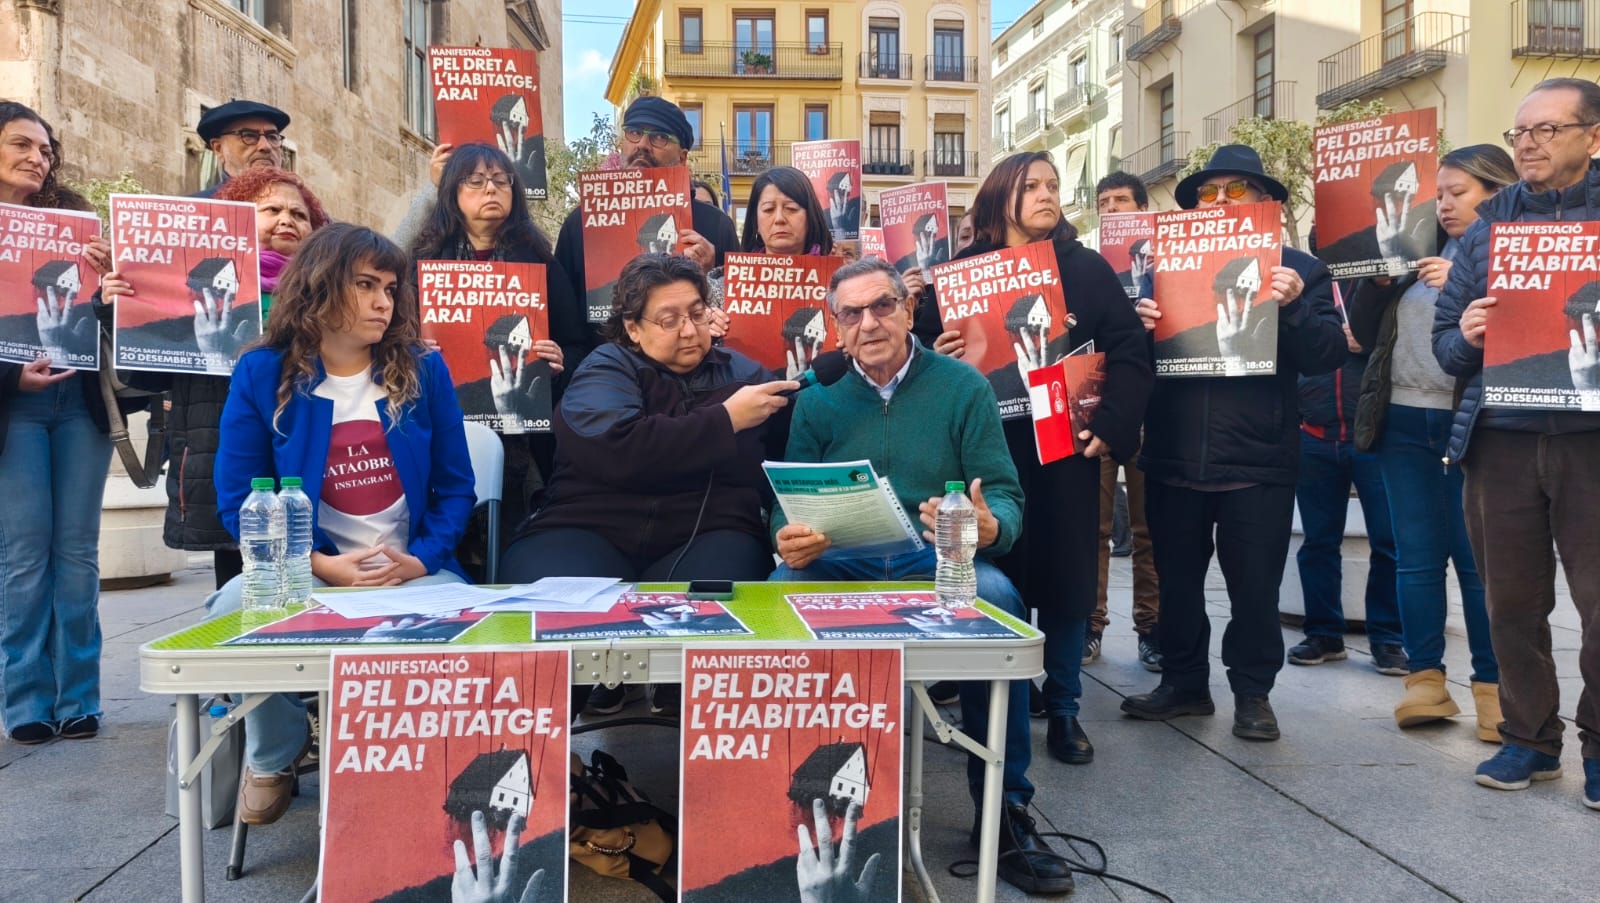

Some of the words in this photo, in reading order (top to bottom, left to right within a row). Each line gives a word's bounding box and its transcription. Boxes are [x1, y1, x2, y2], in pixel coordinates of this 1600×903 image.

[431, 48, 492, 56] MANIFESTACIÓ
[432, 58, 460, 70] PEL
[463, 58, 502, 72] DRET
[505, 60, 516, 72] A
[434, 72, 537, 92] L'HABITATGE,
[436, 88, 478, 100] ARA!
[1316, 118, 1382, 136] MANIFESTACIÓ
[1316, 135, 1344, 152] PEL
[1349, 126, 1394, 146] DRET
[1396, 124, 1410, 138] A
[1316, 137, 1434, 167] L'HABITATGE,
[582, 170, 642, 181] MANIFESTACIÓ
[804, 170, 820, 178] RA!
[1316, 164, 1360, 183] ARA!
[583, 182, 610, 196] PEL
[613, 180, 653, 195] DRET
[655, 178, 668, 192] A
[116, 200, 196, 213] MANIFESTACIÓ
[584, 193, 689, 212] L'HABITATGE,
[882, 198, 897, 208] PEL
[898, 193, 922, 204] DRET
[924, 192, 932, 200] A
[0, 208, 45, 221] FESTACIÓ
[118, 211, 152, 228] PEL
[158, 214, 210, 230] DRET
[212, 218, 227, 232] A
[585, 212, 626, 228] ARA!
[884, 215, 906, 226] ARA!
[1157, 208, 1225, 223] MANIFESTACIÓ
[8, 219, 58, 237] DRET
[59, 226, 73, 240] A
[1158, 223, 1187, 240] PEL
[1190, 218, 1238, 236] DRET
[1239, 217, 1253, 232] A
[1495, 223, 1583, 234] MANIFESTACIÓ
[0, 233, 89, 257] ABITATG
[118, 228, 253, 254] L'HABITATGE,
[1157, 232, 1278, 256] L'HABITATGE,
[1494, 236, 1532, 252] PEL
[1536, 236, 1598, 252] DRET
[0, 249, 21, 263] A!
[118, 247, 172, 264] ARA!
[728, 255, 793, 266] MANIFESTACIÓ
[934, 251, 1001, 276] MANIFESTACIÓ
[1492, 254, 1600, 272] L'HABITA
[421, 263, 493, 272] MANIFESTACIÓ
[1156, 256, 1202, 272] ARA!
[1334, 265, 1376, 276] DESEMBRE
[422, 274, 454, 288] PEL
[458, 274, 505, 289] DRET
[507, 276, 521, 290] A
[728, 265, 756, 281] PEL
[760, 267, 804, 282] DRET
[805, 268, 818, 284] A
[937, 274, 966, 291] PEL
[970, 260, 1014, 282] DRET
[1018, 258, 1031, 272] A
[1490, 274, 1552, 290] ARA!
[727, 282, 826, 300] L'HABITATG
[940, 270, 1058, 307] L'HABITATGE,
[422, 290, 546, 310] L'HABITATGE,
[726, 300, 771, 315] ARA!
[422, 308, 472, 324] ARA!
[590, 310, 601, 318] 20
[944, 298, 988, 322] ARA!
[0, 346, 35, 357] SEMBRE
[68, 353, 94, 362] 18:00
[120, 352, 136, 360] 20
[138, 354, 192, 364] DESEMBRE
[1156, 364, 1168, 372] 20
[1169, 363, 1214, 372] DESEMBRE
[1246, 360, 1273, 369] 18:00
[1485, 386, 1508, 394] PLAÇA
[1485, 393, 1502, 402] 20
[1504, 394, 1566, 404] DESEMBRE
[1000, 404, 1024, 415] MBRE
[524, 420, 550, 428] 18:00
[348, 444, 369, 457] LA
[323, 457, 394, 478] ATAOBR
[334, 474, 392, 490] INSTAGRAM
[340, 656, 470, 676] MANIFESTACIÓ
[692, 652, 810, 668] MANIFESTACIÓ
[339, 680, 396, 707] PEL
[404, 678, 490, 706] DRET
[493, 676, 519, 704] A
[691, 674, 744, 698] PEL
[750, 673, 830, 698] DRET
[832, 673, 856, 698] A
[338, 708, 562, 740] L'HABITATGE,
[690, 702, 896, 734] L'HABITATGE,
[688, 734, 770, 760] ARA!
[335, 744, 426, 774] ARA!
